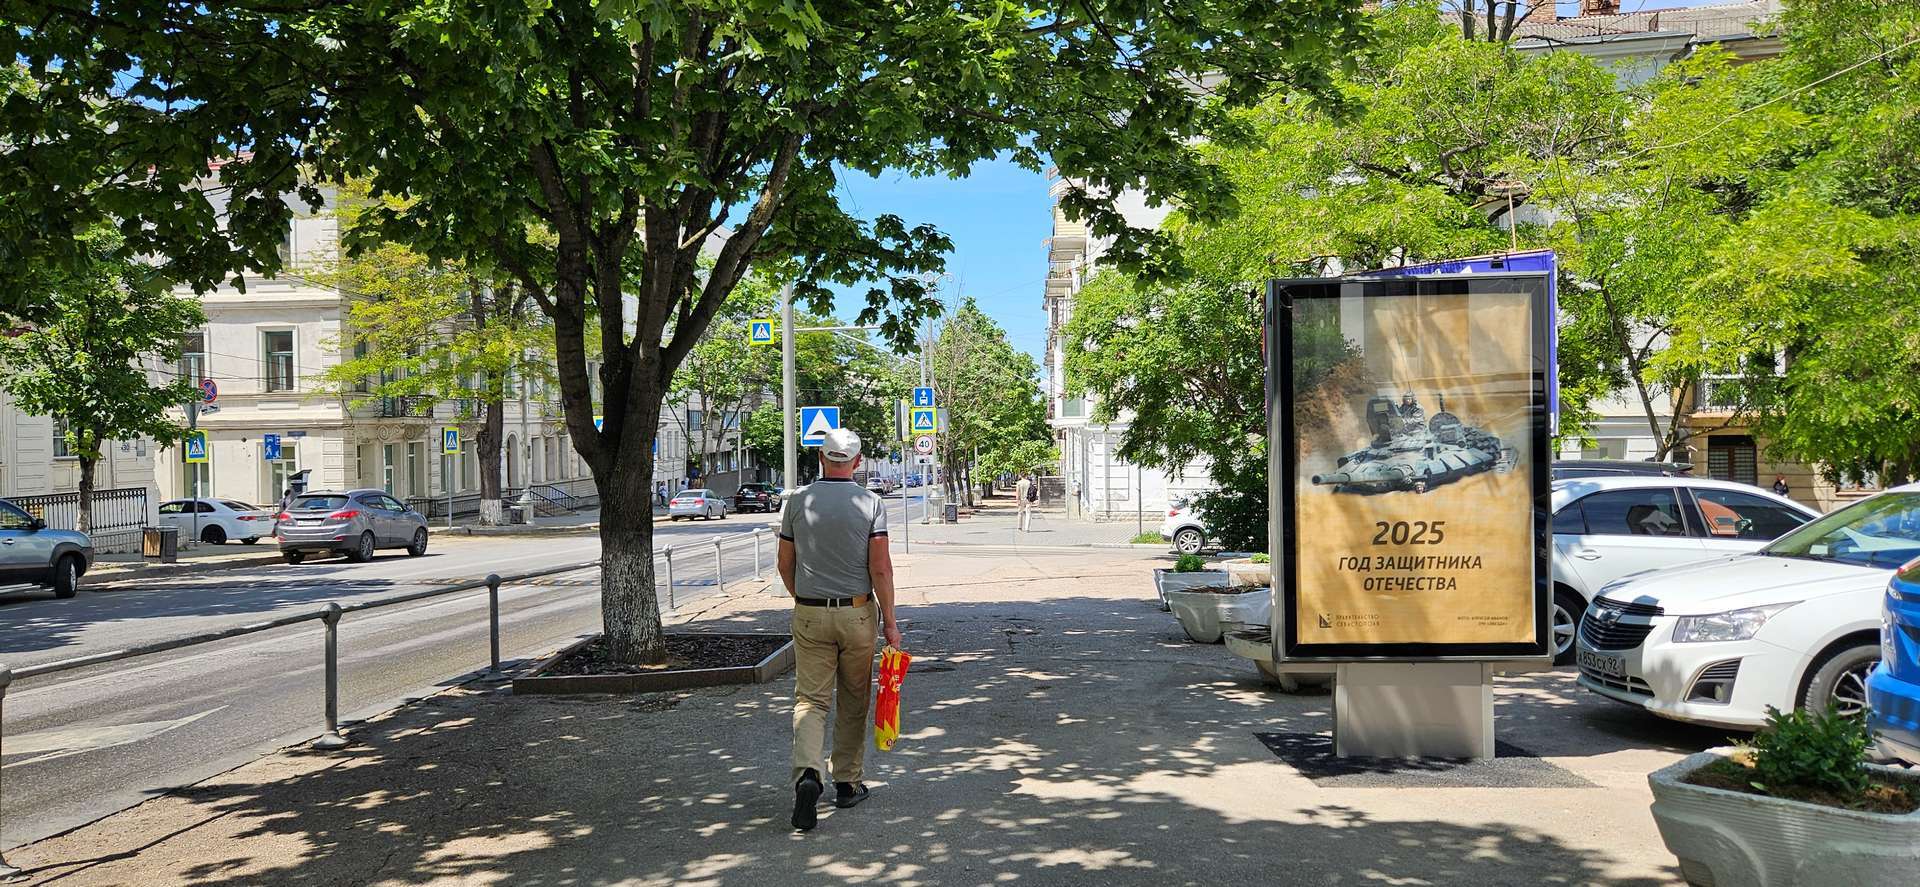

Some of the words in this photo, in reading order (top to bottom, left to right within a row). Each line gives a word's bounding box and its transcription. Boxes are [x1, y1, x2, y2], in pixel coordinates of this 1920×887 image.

[1372, 521, 1446, 545] 2025
[1338, 556, 1371, 572] ГОД
[1374, 555, 1482, 572] ЗАЩИТНИКА
[1363, 576, 1457, 591] ОТЕЧЕСТВА
[1608, 656, 1617, 671] 92
